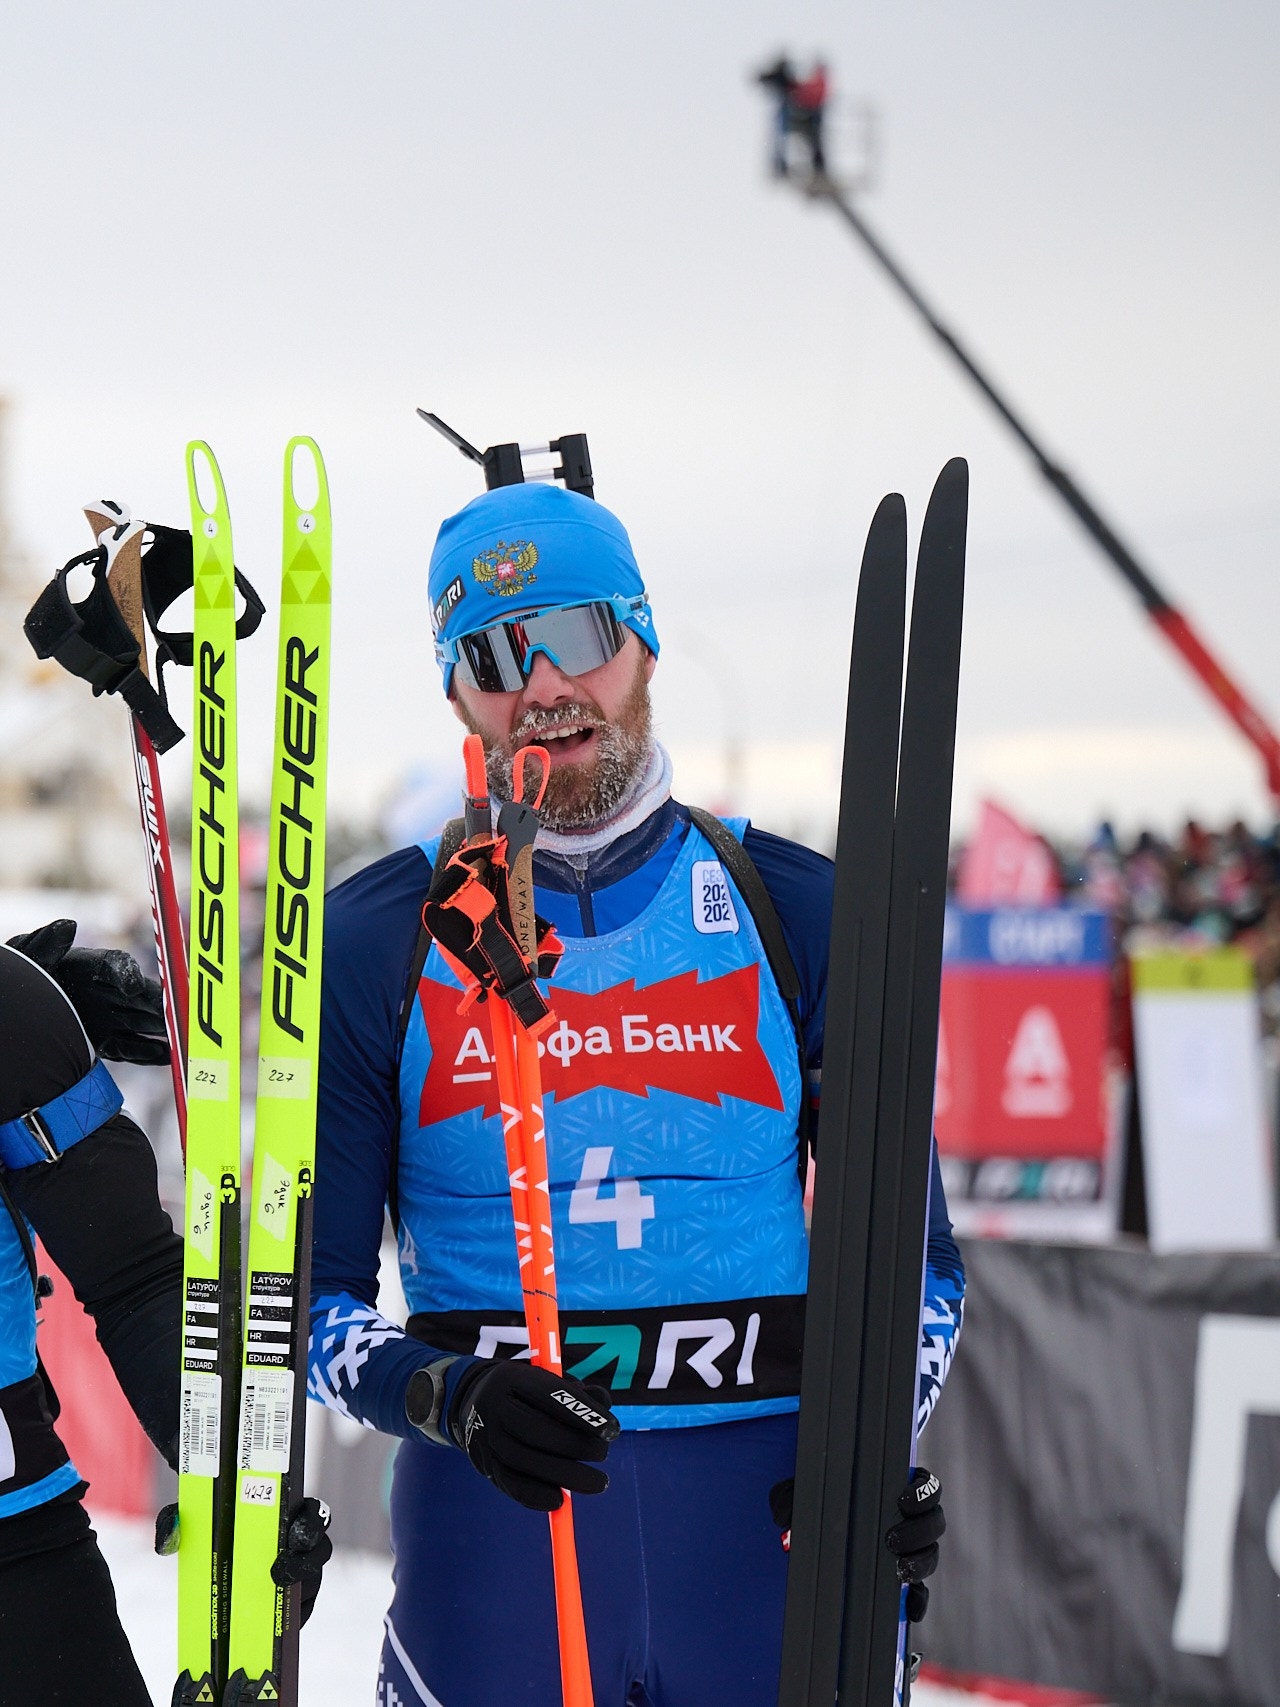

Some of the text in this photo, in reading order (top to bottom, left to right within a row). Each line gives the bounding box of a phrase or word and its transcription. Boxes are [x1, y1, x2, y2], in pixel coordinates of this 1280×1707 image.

[208, 523, 214, 534] 4
[303, 518, 310, 530] 4
[197, 640, 226, 1049] FISCHER
[272, 636, 320, 1043] FISCHER
[621, 1014, 742, 1054] Банк
[569, 1146, 655, 1250] 4
[252, 1276, 292, 1286] LATYPOV
[187, 1282, 219, 1293] LATYPOV
[186, 1314, 197, 1323] FA
[251, 1309, 263, 1318] FA
[186, 1337, 196, 1346] HR
[249, 1332, 262, 1341] HR
[248, 1354, 284, 1364] EDUARD
[185, 1360, 213, 1370] EDUARD
